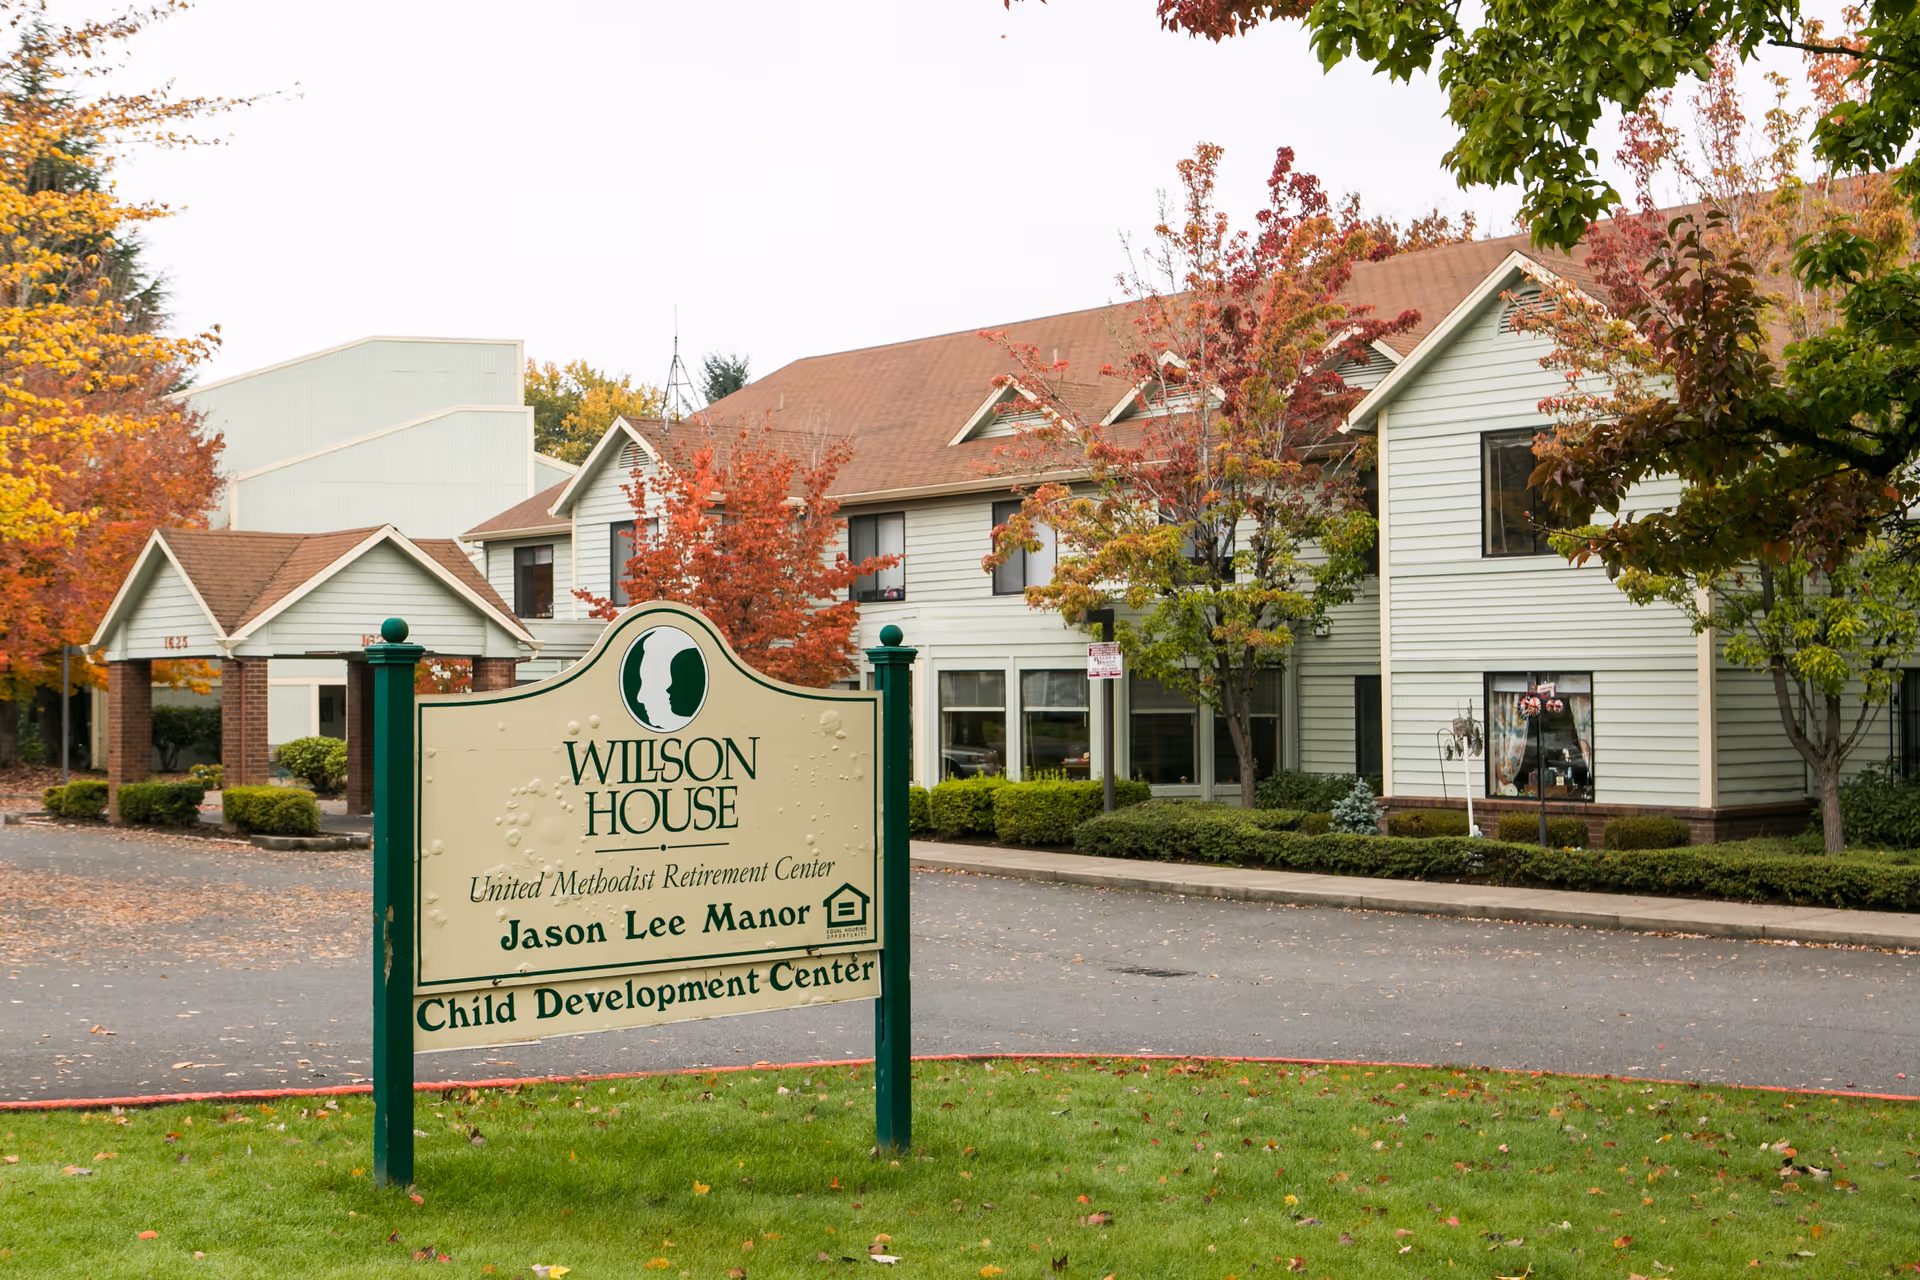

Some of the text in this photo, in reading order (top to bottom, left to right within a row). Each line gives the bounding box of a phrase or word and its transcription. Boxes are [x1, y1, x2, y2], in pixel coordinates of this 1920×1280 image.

[361, 634, 385, 647] 162
[563, 737, 760, 786] WILLSON
[585, 786, 739, 836] HOUSE
[470, 856, 836, 903] United Methodist Retirement Center
[501, 903, 811, 951] Jason Lee Manor
[826, 931, 867, 939] OPPORTUNITY
[416, 958, 875, 1032] Child Development Center
